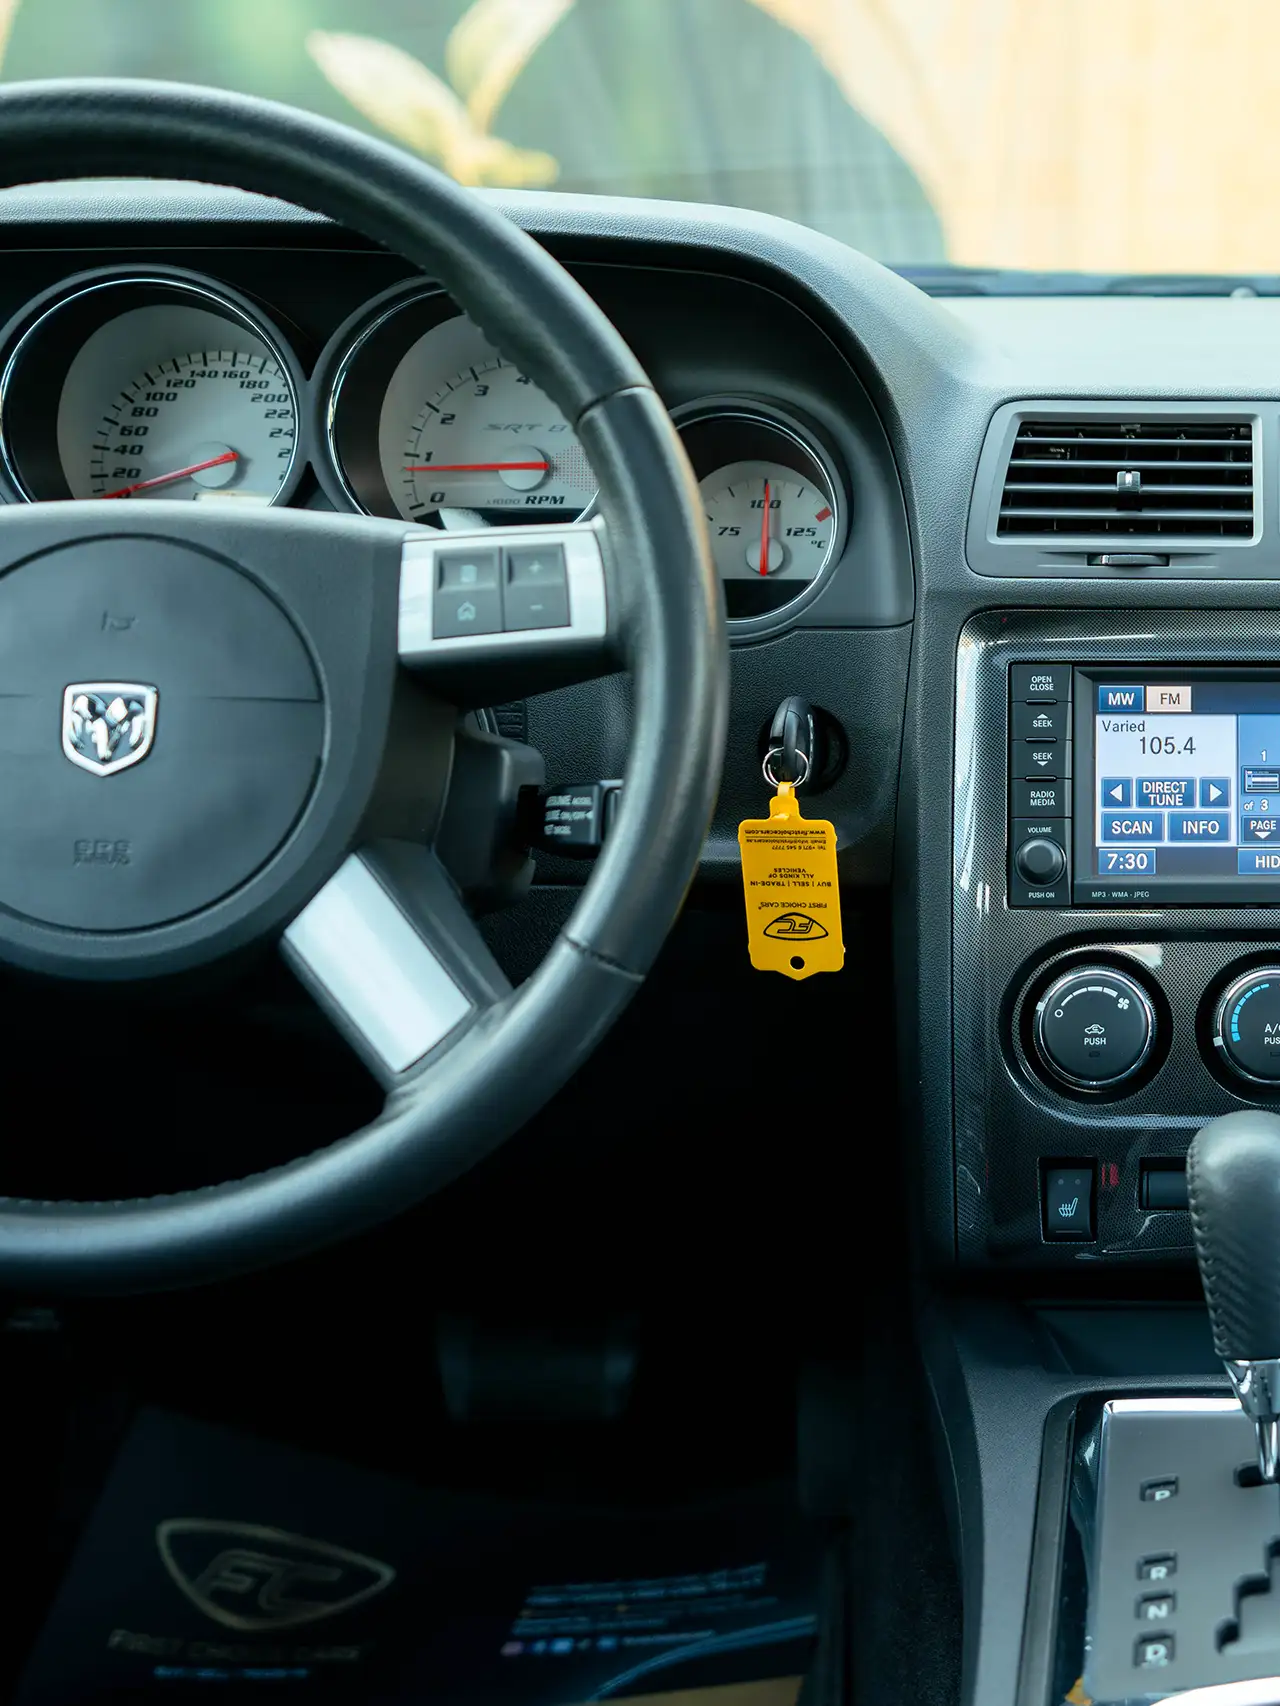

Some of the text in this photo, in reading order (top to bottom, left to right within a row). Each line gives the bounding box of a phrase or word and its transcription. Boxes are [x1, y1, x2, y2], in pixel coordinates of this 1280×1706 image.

[189, 370, 219, 379] 140
[222, 370, 250, 379] 160
[165, 379, 196, 388] 120
[239, 380, 270, 389] 180
[516, 376, 532, 385] 4
[474, 385, 490, 397] 3
[144, 392, 178, 402] 100
[250, 393, 289, 403] 200
[131, 407, 159, 418] 80
[264, 409, 294, 419] 22
[440, 413, 456, 425] 2
[119, 425, 149, 436] 60
[114, 445, 144, 455] 40
[424, 451, 433, 462] 1
[112, 468, 142, 478] 20
[430, 492, 445, 503] 0
[525, 495, 565, 505] RPM
[750, 499, 782, 509] 100
[718, 526, 741, 536] 75
[786, 527, 817, 537] 125
[1031, 675, 1052, 683] OPEN
[1108, 693, 1135, 706] MW
[1160, 693, 1181, 705] FM
[1032, 720, 1053, 728] SEEK
[1102, 720, 1146, 733] Varied
[1139, 736, 1196, 755] 105.4
[1032, 752, 1053, 760] SEEK
[1261, 750, 1267, 762] 1
[1142, 781, 1187, 794] DIRECT
[1030, 790, 1055, 798] RADIO
[1030, 798, 1056, 806] MEDIA
[1148, 794, 1183, 806] TUNE
[1244, 800, 1269, 811] of 3
[1111, 821, 1153, 834] SCAN
[1182, 821, 1220, 834] INFO
[1250, 820, 1277, 831] PAGE
[1107, 853, 1148, 870] 7:30
[1084, 1037, 1106, 1045] PUSH
[1155, 1490, 1170, 1500] P
[1150, 1567, 1167, 1580] R
[1147, 1604, 1168, 1620] N
[1145, 1644, 1167, 1661] D
